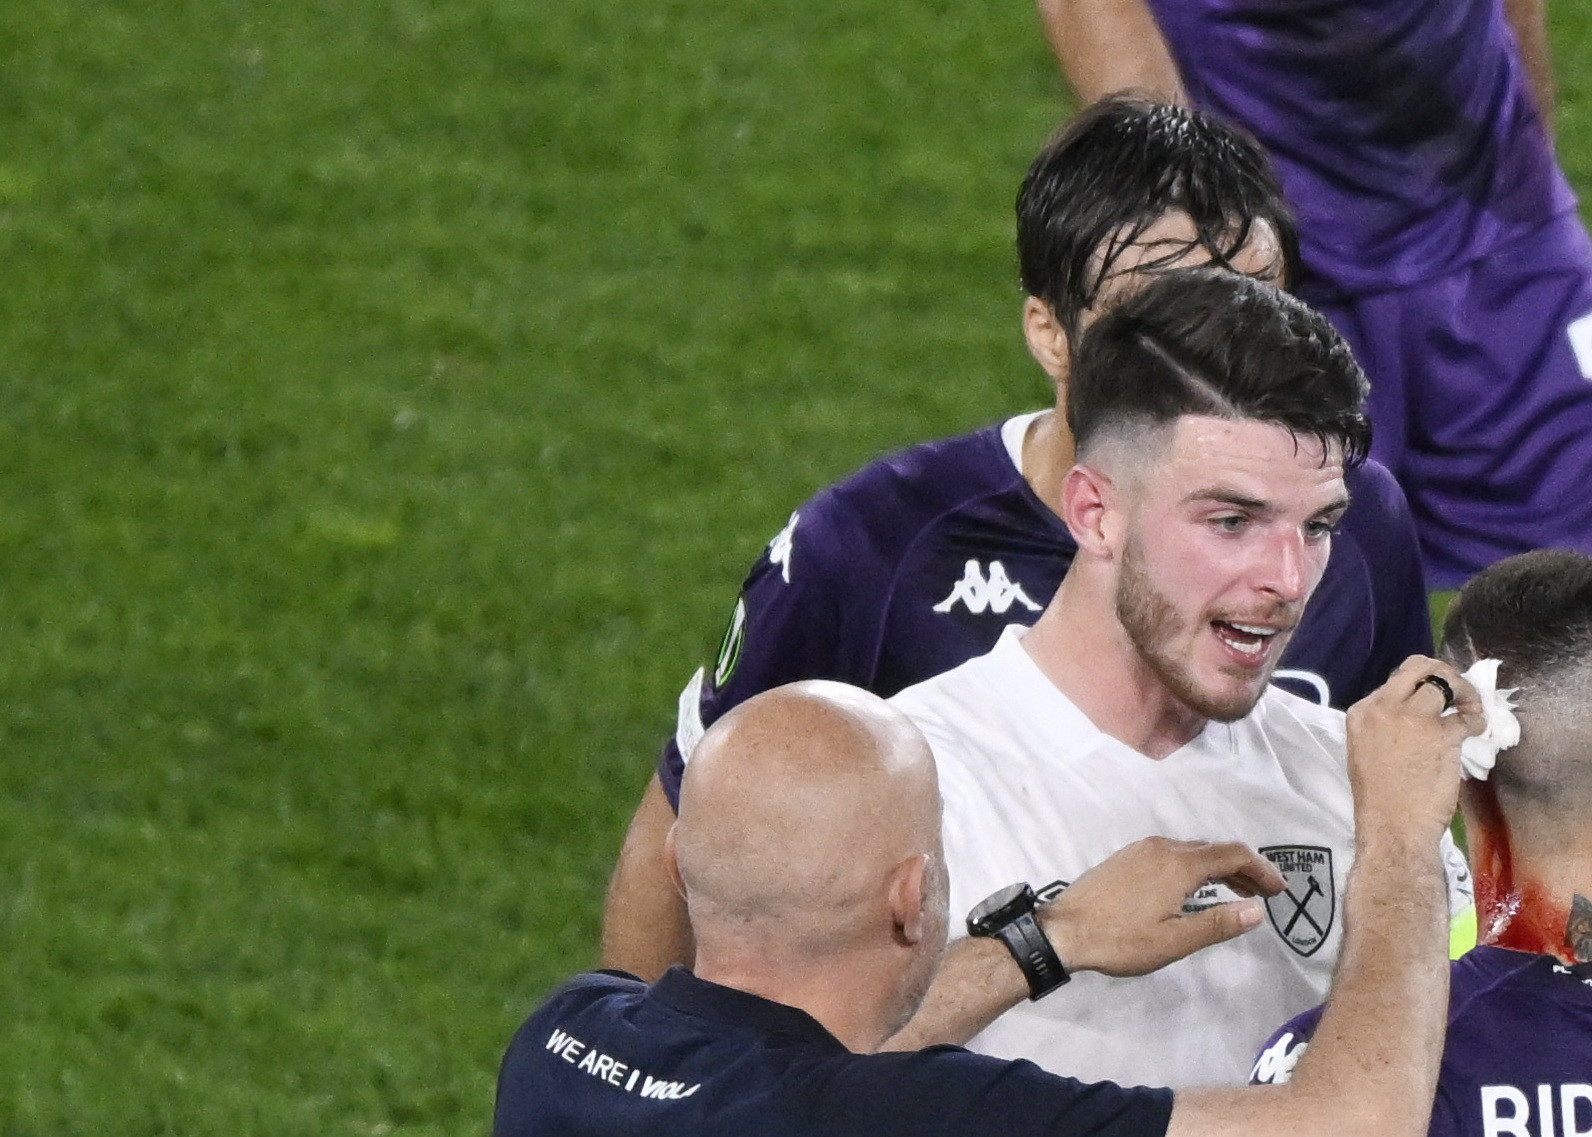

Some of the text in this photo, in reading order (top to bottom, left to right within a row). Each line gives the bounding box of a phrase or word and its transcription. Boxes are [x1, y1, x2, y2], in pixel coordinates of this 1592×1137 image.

[1266, 851, 1325, 864] WEST HAM
[546, 1028, 586, 1064] WE
[578, 1049, 628, 1086] ARE
